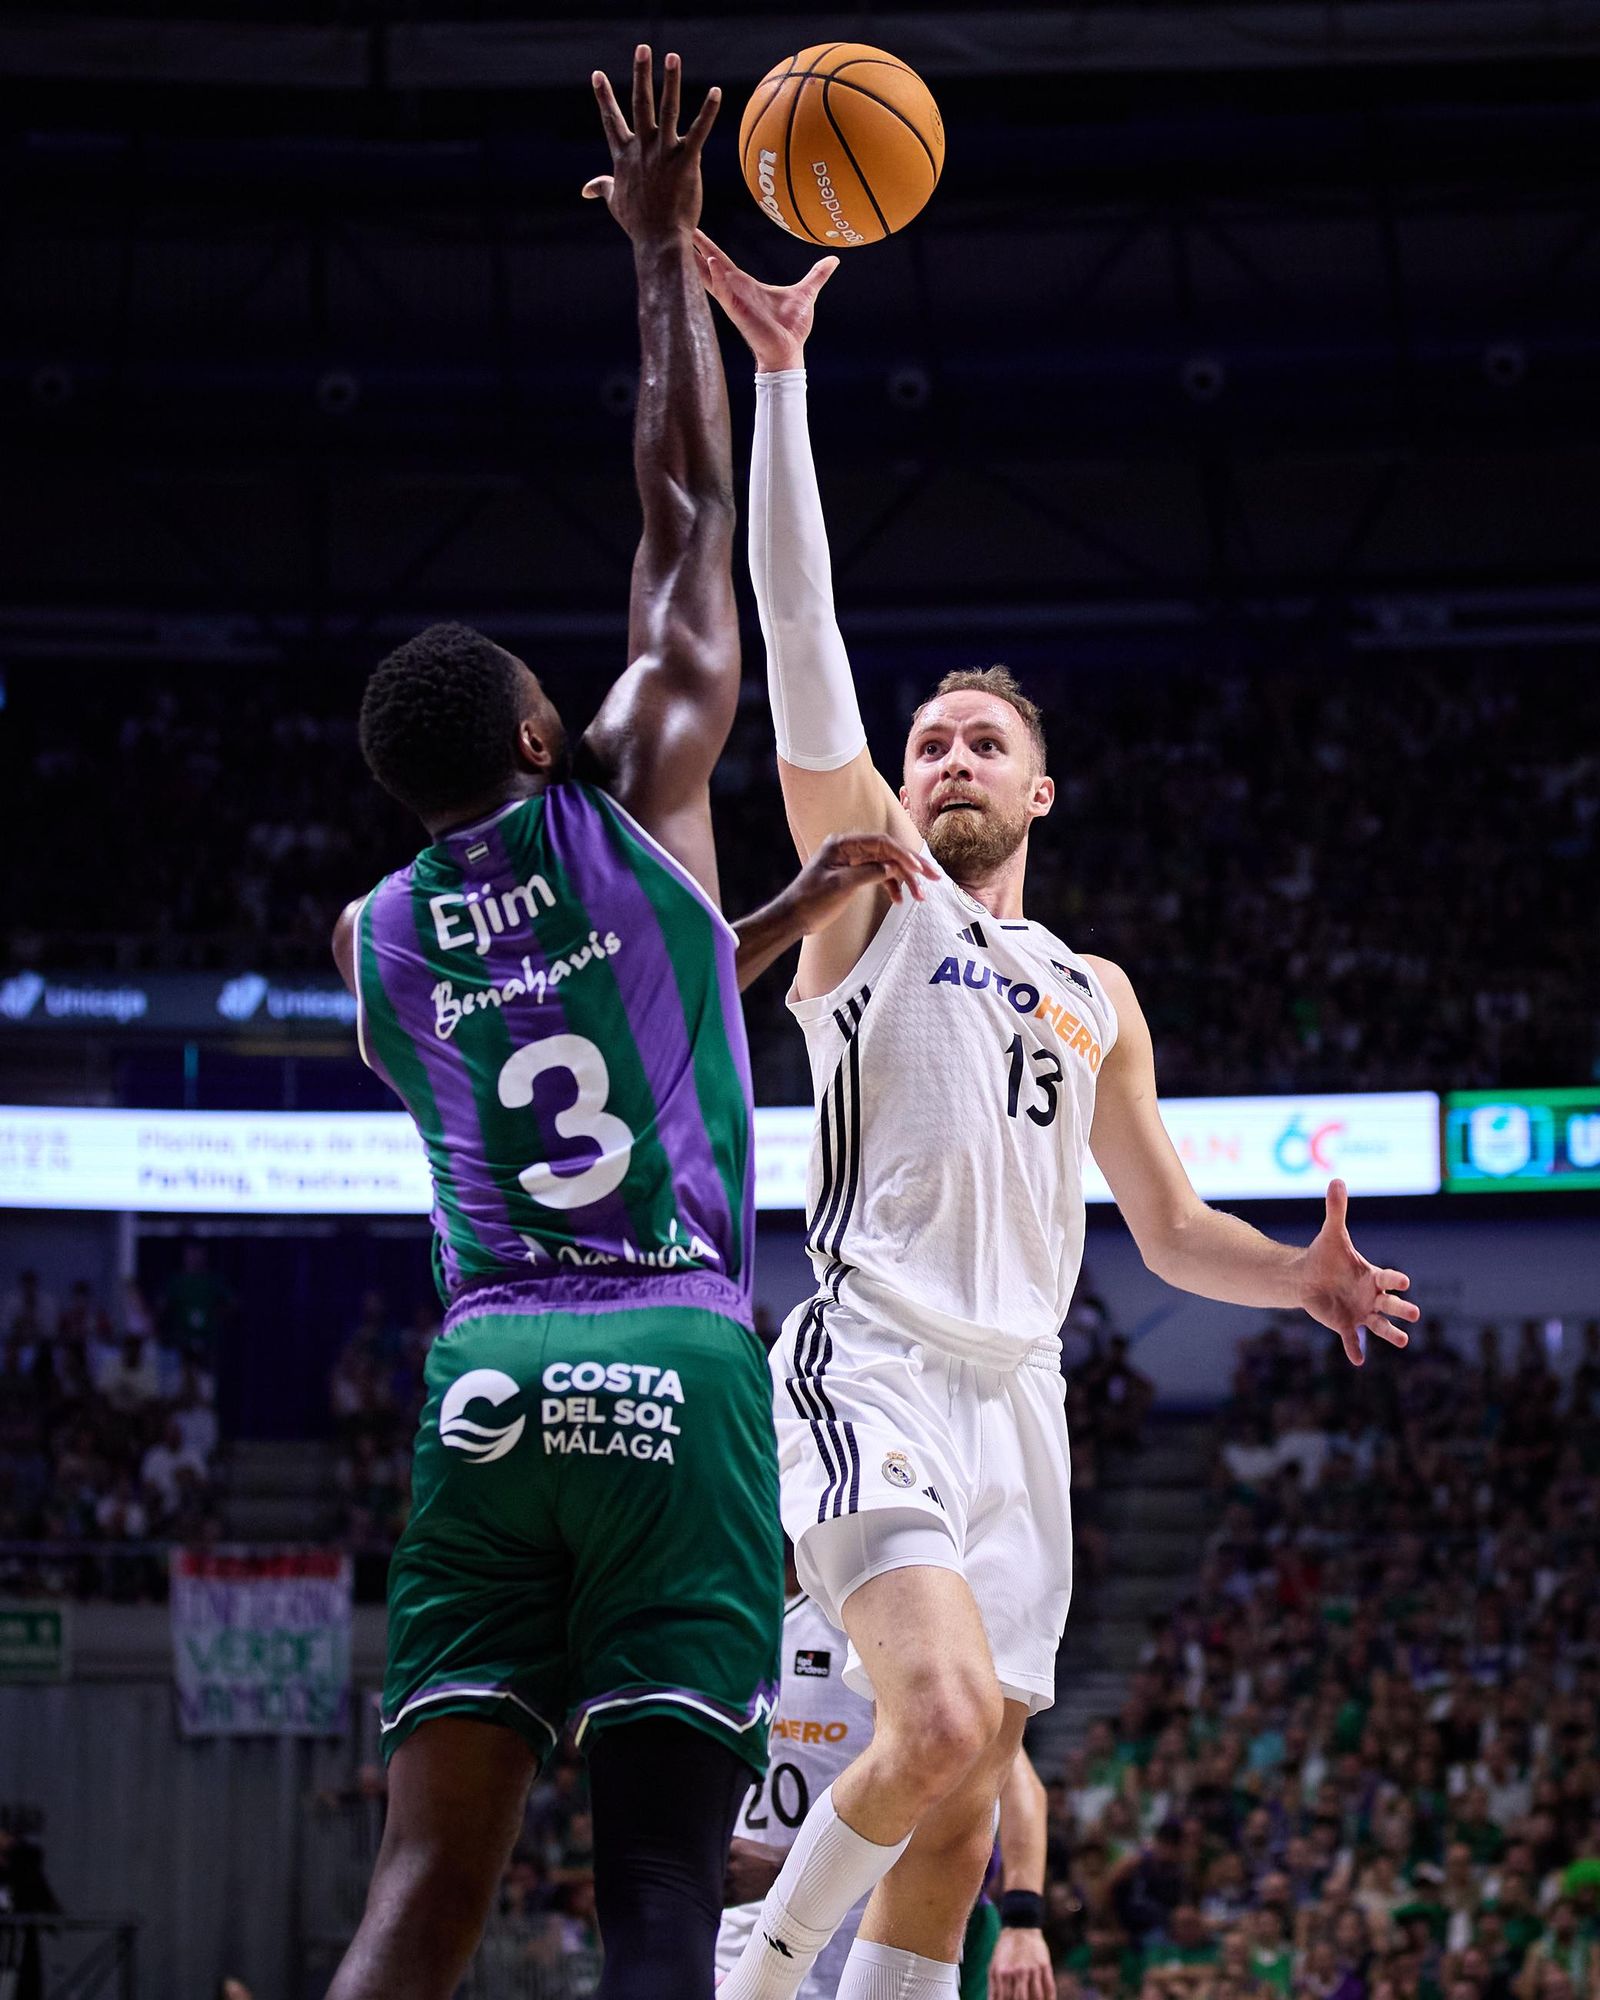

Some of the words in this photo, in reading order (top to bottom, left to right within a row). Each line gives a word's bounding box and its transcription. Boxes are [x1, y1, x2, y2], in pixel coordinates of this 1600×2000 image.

[429, 874, 556, 955] Ejim
[929, 956, 1101, 1073] AUTOHERO
[1006, 1033, 1063, 1127] 13
[498, 1034, 635, 1210] 3
[541, 1397, 606, 1425] DEL
[612, 1399, 681, 1435] SOL
[543, 1361, 685, 1404] COSTA
[543, 1424, 675, 1465] MÁLAGA
[745, 1763, 809, 1830] 20
